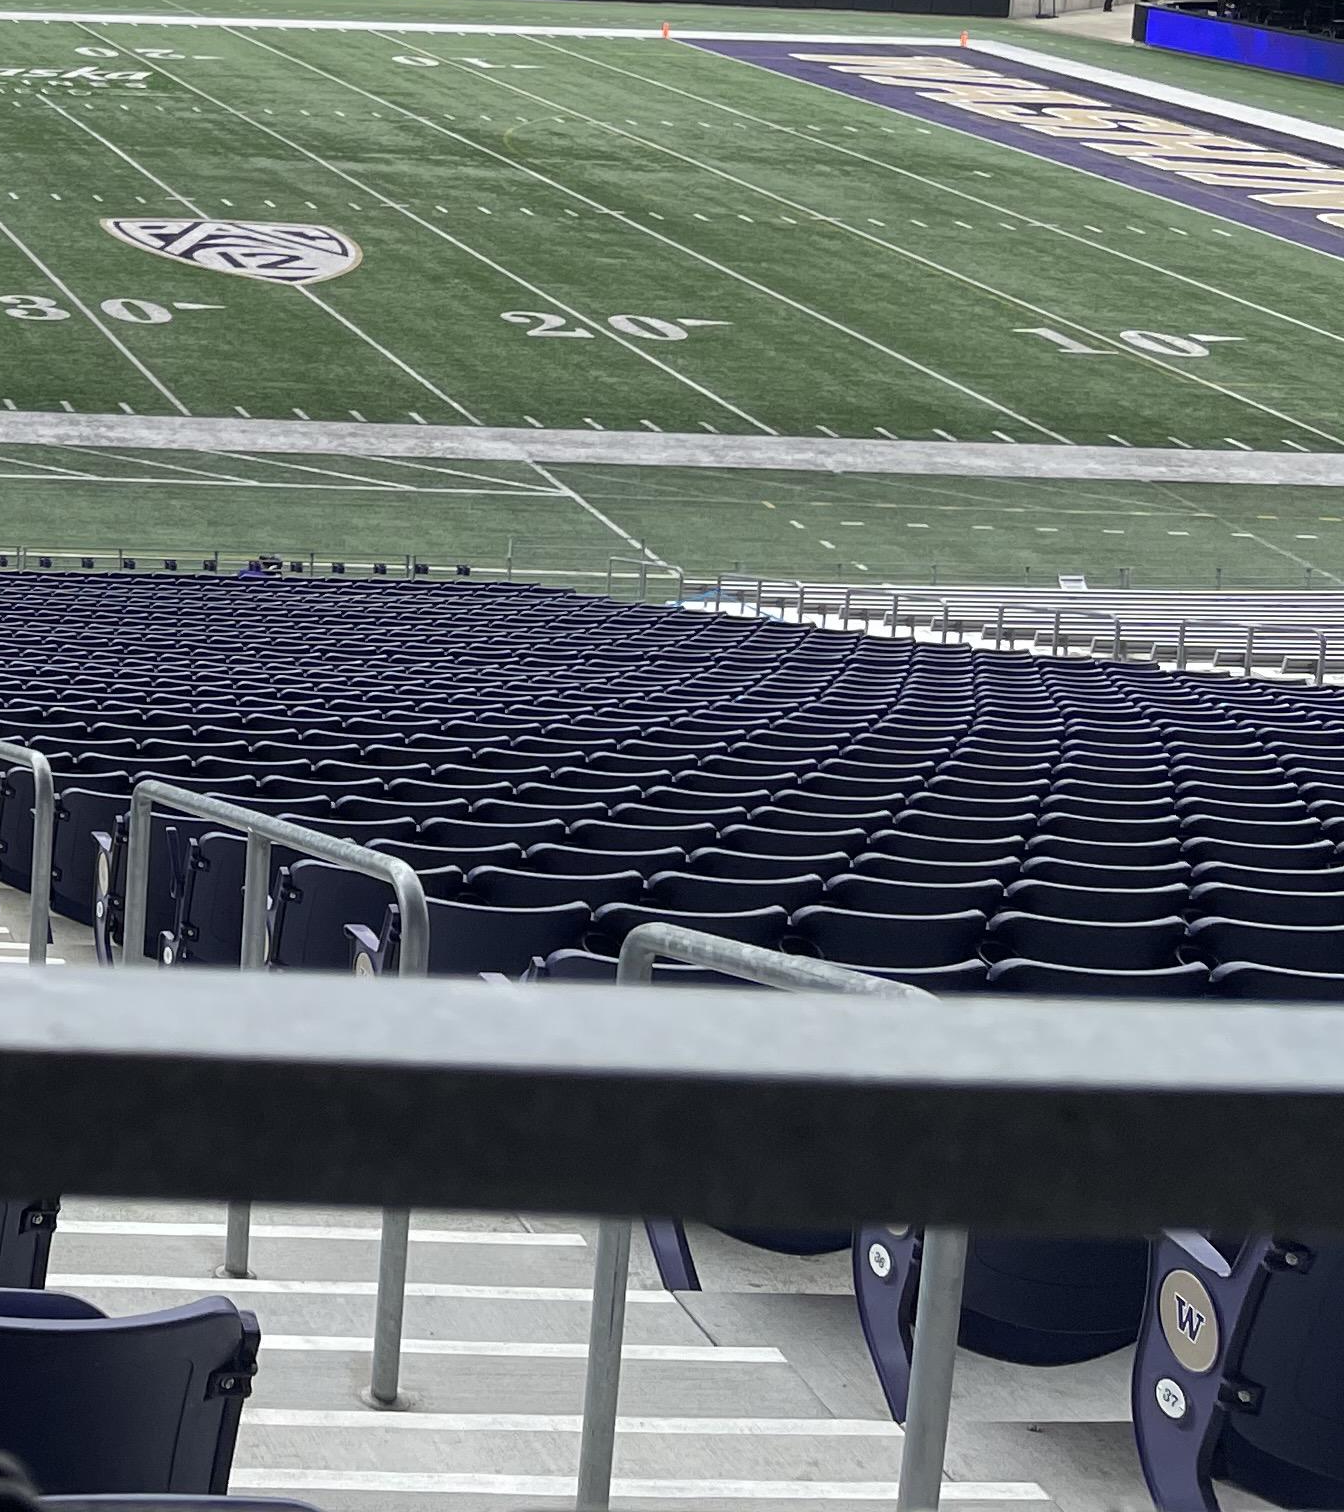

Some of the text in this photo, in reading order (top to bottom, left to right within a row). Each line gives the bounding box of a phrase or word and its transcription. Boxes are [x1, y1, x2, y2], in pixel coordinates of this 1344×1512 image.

[788, 53, 1344, 229] WASHIN
[1174, 1292, 1207, 1344] W
[1162, 1388, 1180, 1408] 37
